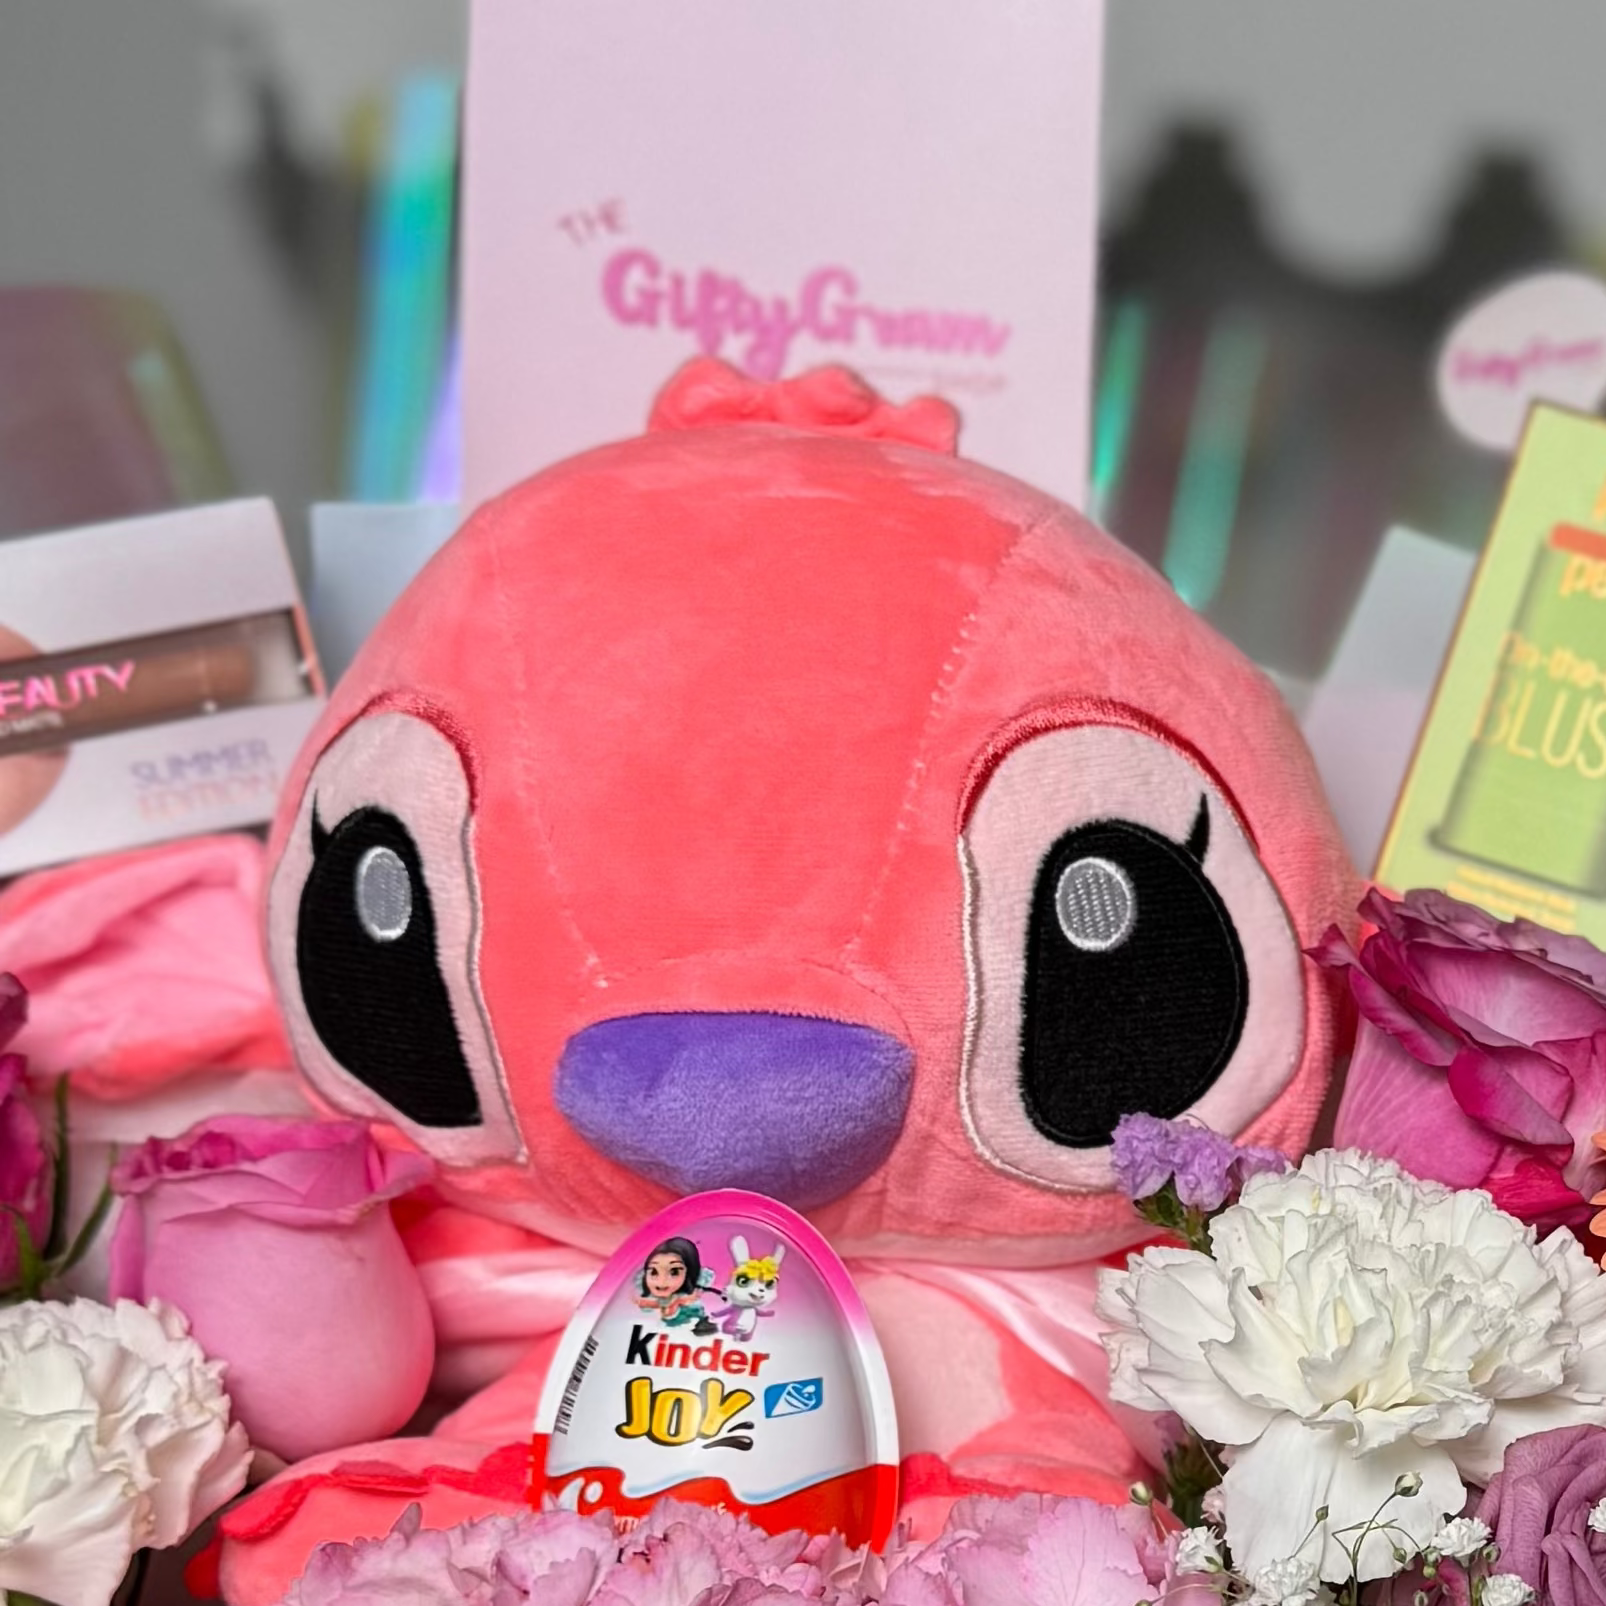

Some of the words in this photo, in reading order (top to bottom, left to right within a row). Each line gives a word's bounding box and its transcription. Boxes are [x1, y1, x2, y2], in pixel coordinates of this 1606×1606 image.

[130, 738, 272, 787] SUMMER
[625, 1323, 771, 1378] Kinder
[615, 1377, 756, 1447] JOY
